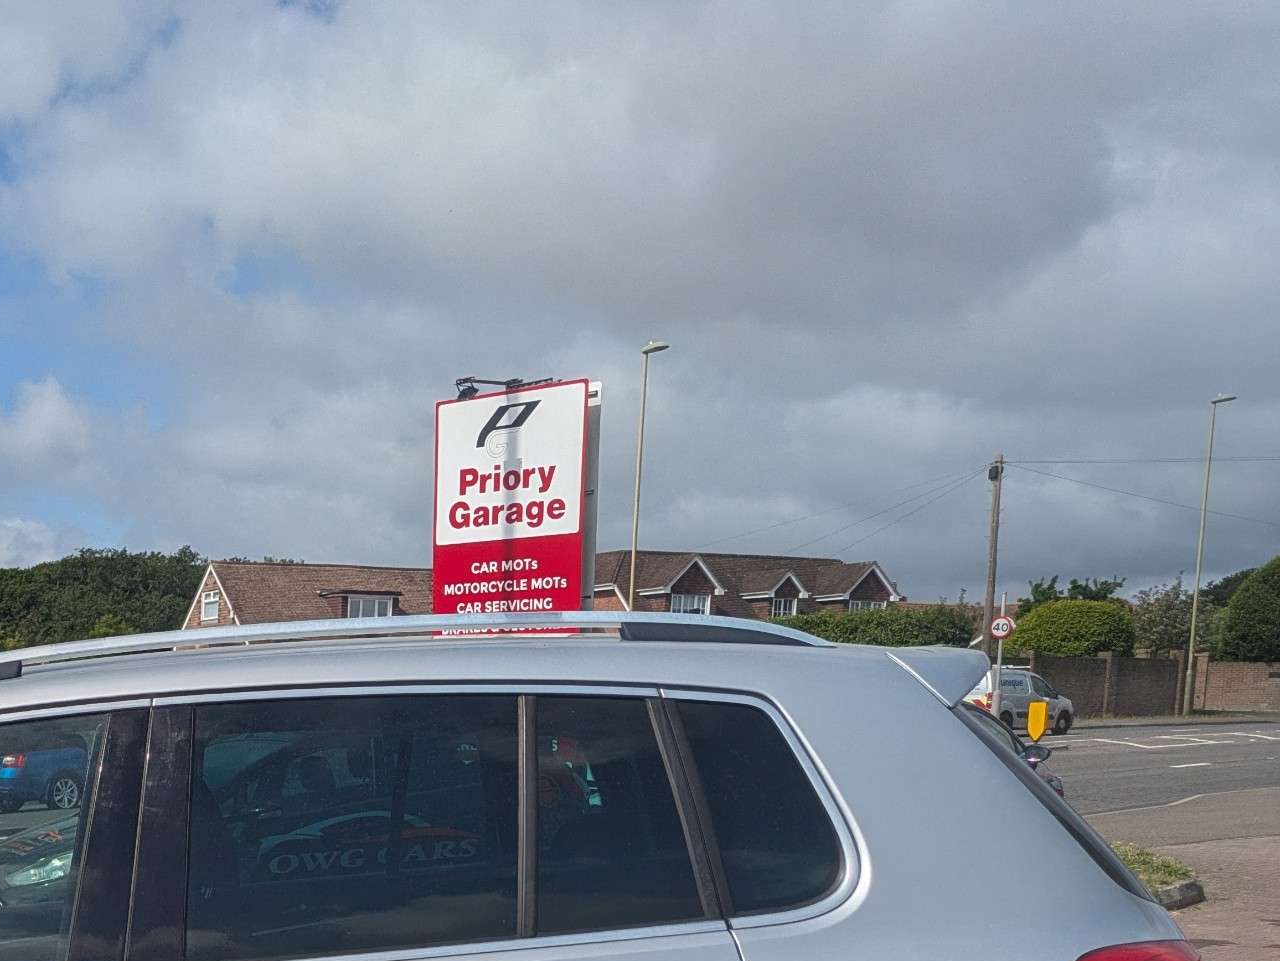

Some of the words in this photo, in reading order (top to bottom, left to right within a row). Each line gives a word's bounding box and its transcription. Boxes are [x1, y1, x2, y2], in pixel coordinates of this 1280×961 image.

[459, 464, 557, 496] Priory
[448, 498, 566, 529] Garage
[471, 561, 498, 574] CAR
[501, 558, 538, 572] MOTs
[444, 579, 528, 596] MOTORCYCLE
[530, 576, 567, 590] MOTs
[456, 602, 482, 614] CAR
[484, 597, 553, 613] SERVICING
[992, 622, 1009, 632] 40
